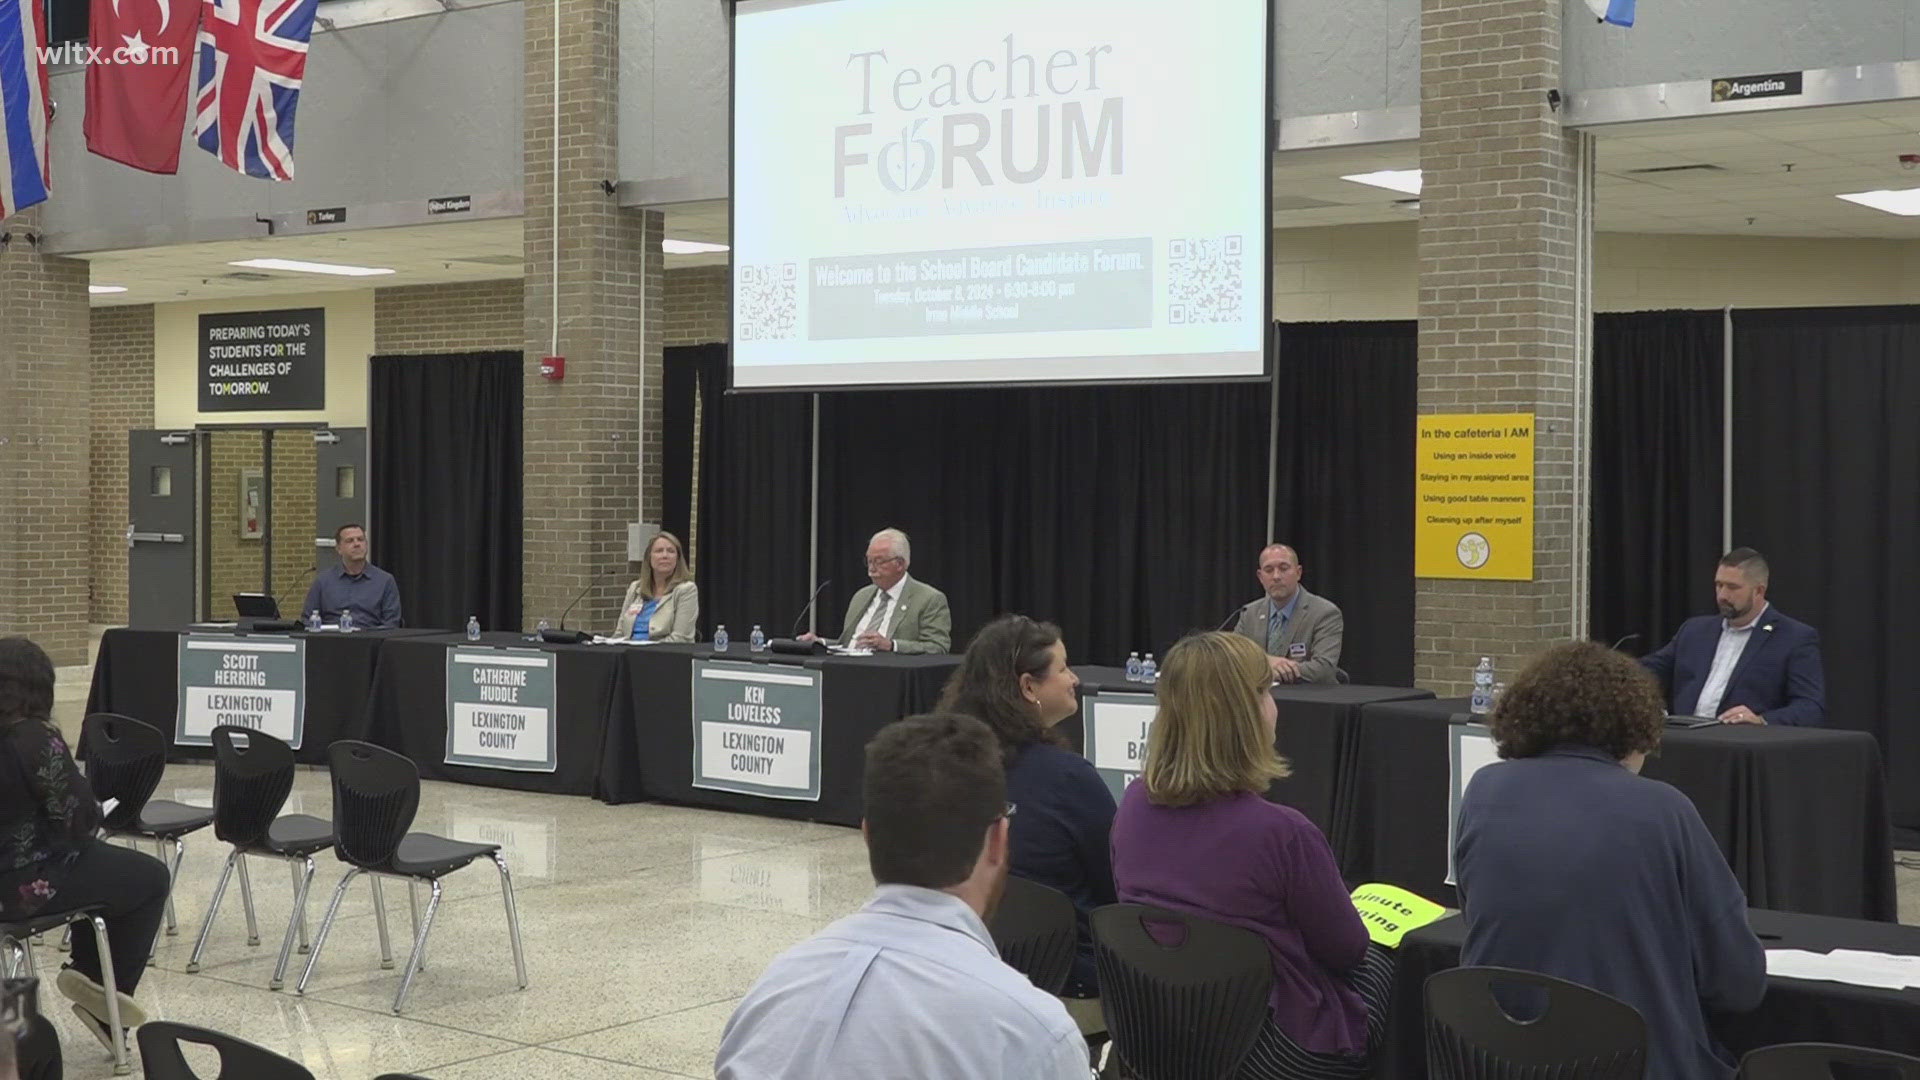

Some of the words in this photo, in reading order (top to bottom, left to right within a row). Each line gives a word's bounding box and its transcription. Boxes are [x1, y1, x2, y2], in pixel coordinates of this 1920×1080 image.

[846, 33, 1112, 115] Teacher
[1731, 80, 1785, 96] Argentina
[834, 97, 1124, 198] FORUM
[816, 264, 874, 287] Welcome
[877, 263, 891, 284] to
[895, 261, 917, 282] the
[920, 256, 967, 281] School
[970, 254, 1012, 279] Board
[1015, 251, 1090, 276] Candidate
[1093, 248, 1144, 272] Forum.
[914, 286, 953, 304] October
[967, 282, 993, 300] 2024
[1058, 282, 1075, 300] pm
[985, 302, 1019, 320] School
[209, 326, 265, 341] PREPARING
[266, 323, 311, 338] TODAY'S
[209, 344, 262, 359] STUDENTS
[263, 344, 284, 357] FOR
[285, 342, 307, 356] THE
[209, 362, 276, 377] CHALLENGES
[277, 362, 292, 375] OF
[209, 381, 270, 395] TOMORROW.
[1421, 429, 1431, 438] In
[1434, 428, 1451, 438] the
[1454, 428, 1501, 439] cafeteria
[1510, 428, 1529, 438] AM
[1433, 452, 1456, 461] Using
[1469, 452, 1492, 460] inside
[1494, 452, 1516, 460] voice
[1420, 473, 1449, 482] Staying
[1451, 473, 1458, 481] in
[1460, 474, 1472, 482] my
[1473, 473, 1509, 482] assigned
[1423, 495, 1446, 504] Using
[1447, 494, 1468, 503] good
[1469, 494, 1489, 502] table
[1426, 515, 1461, 525] Cleaning
[1462, 517, 1473, 525] up
[1474, 516, 1493, 524] after
[1495, 516, 1522, 525] myself
[222, 654, 259, 670] SCOTT
[214, 669, 266, 686] HERRING
[473, 667, 527, 687] CATHERINE
[207, 694, 273, 712] LEXINGTON
[480, 685, 519, 703] HUDDLE
[744, 686, 765, 704] KEN
[216, 713, 264, 730] COUNTY
[472, 711, 526, 731] LEXINGTON
[727, 703, 781, 725] LOVELESS
[479, 731, 517, 750] COUNTY
[722, 731, 785, 755] LEXINGTON
[730, 753, 774, 775] COUNTY
